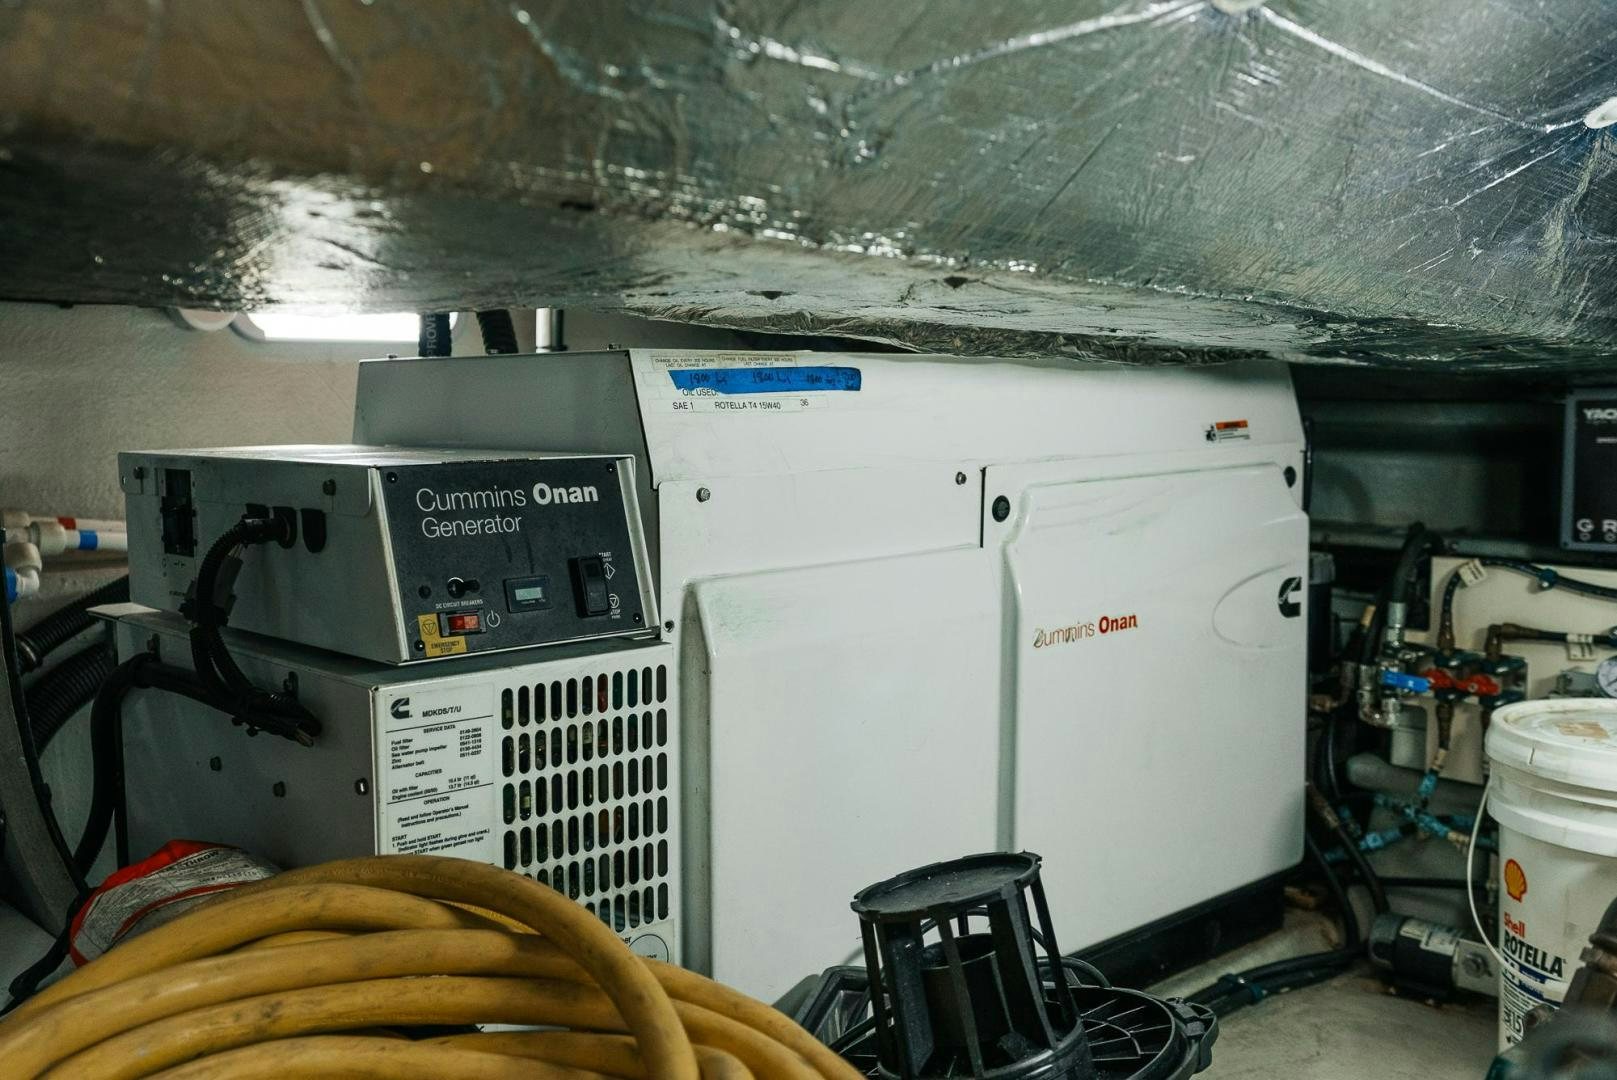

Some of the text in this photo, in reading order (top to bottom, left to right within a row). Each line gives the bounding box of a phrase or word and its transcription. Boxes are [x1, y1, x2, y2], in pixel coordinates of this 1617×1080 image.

[672, 402, 688, 410] SAE
[714, 401, 747, 410] ROTELLA
[759, 402, 782, 410] 15W40
[416, 482, 599, 512] Cummins Onan
[421, 516, 522, 538] Generator
[1033, 614, 1138, 648] Cummins Onan
[431, 640, 460, 648] EMERGENCY
[422, 706, 462, 718] MDKDS/T/U
[424, 726, 443, 734] SERVICE
[415, 748, 428, 756] pump
[414, 768, 442, 778] CAPACITIES
[424, 796, 450, 805] OPERATION
[432, 808, 454, 816] Operator's
[401, 820, 426, 828] instructions
[435, 812, 462, 822] precautions.)
[476, 828, 490, 836] crank.)
[392, 834, 408, 842] START
[1504, 911, 1525, 939] Shell
[1504, 929, 1563, 978] ROTELLA
